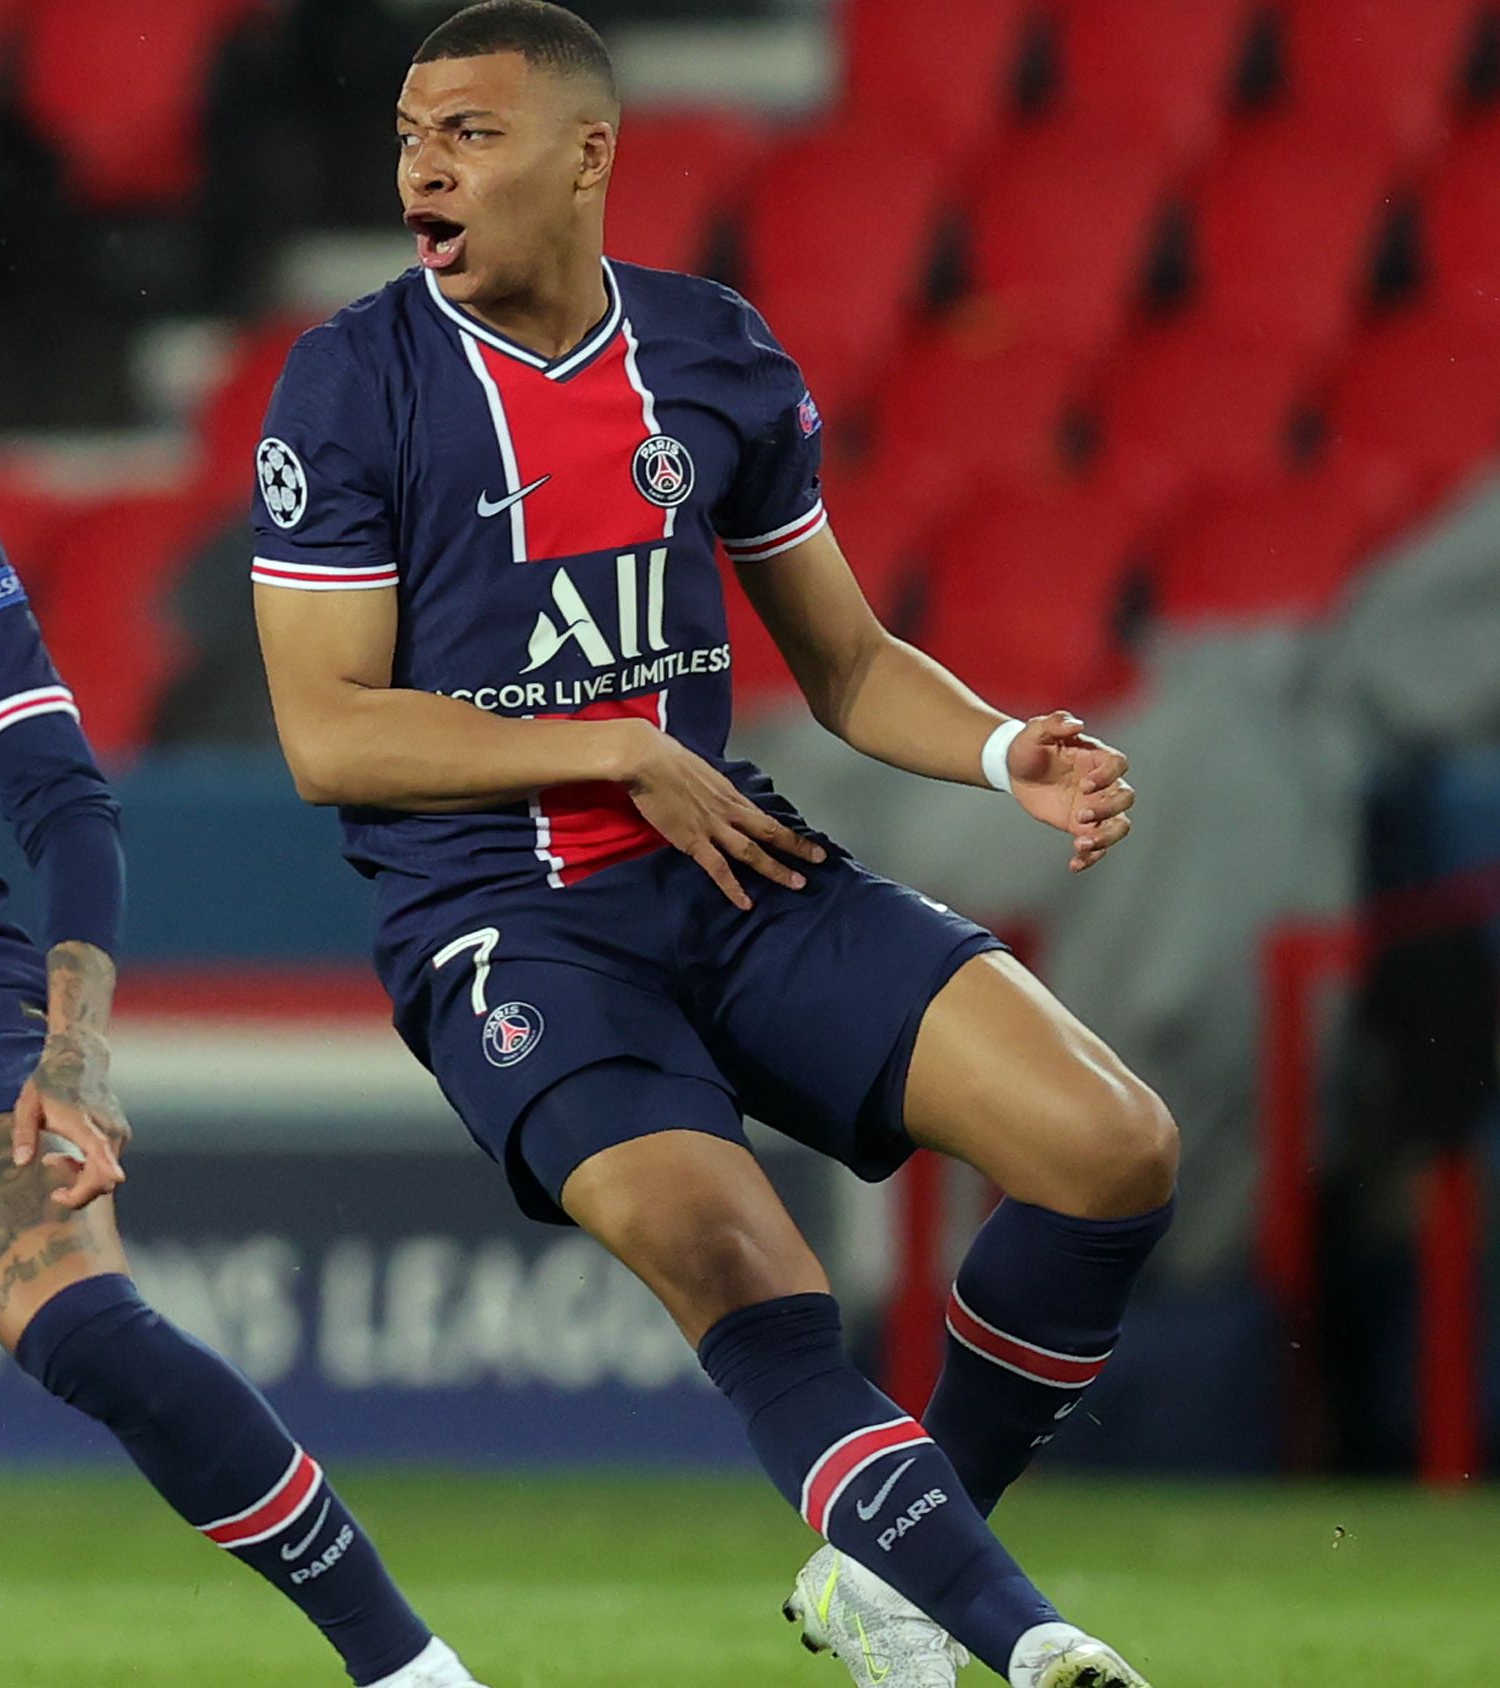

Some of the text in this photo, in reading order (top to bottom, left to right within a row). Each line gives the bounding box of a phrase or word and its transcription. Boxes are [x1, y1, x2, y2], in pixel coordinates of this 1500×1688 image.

[640, 439, 680, 460] PARIS
[555, 672, 617, 705] LIVE
[621, 644, 730, 691] LIMITLESS
[432, 927, 500, 1016] 7
[484, 1005, 520, 1039] PARIS
[876, 1488, 948, 1552] PARIS
[289, 1524, 354, 1585] PARIS
